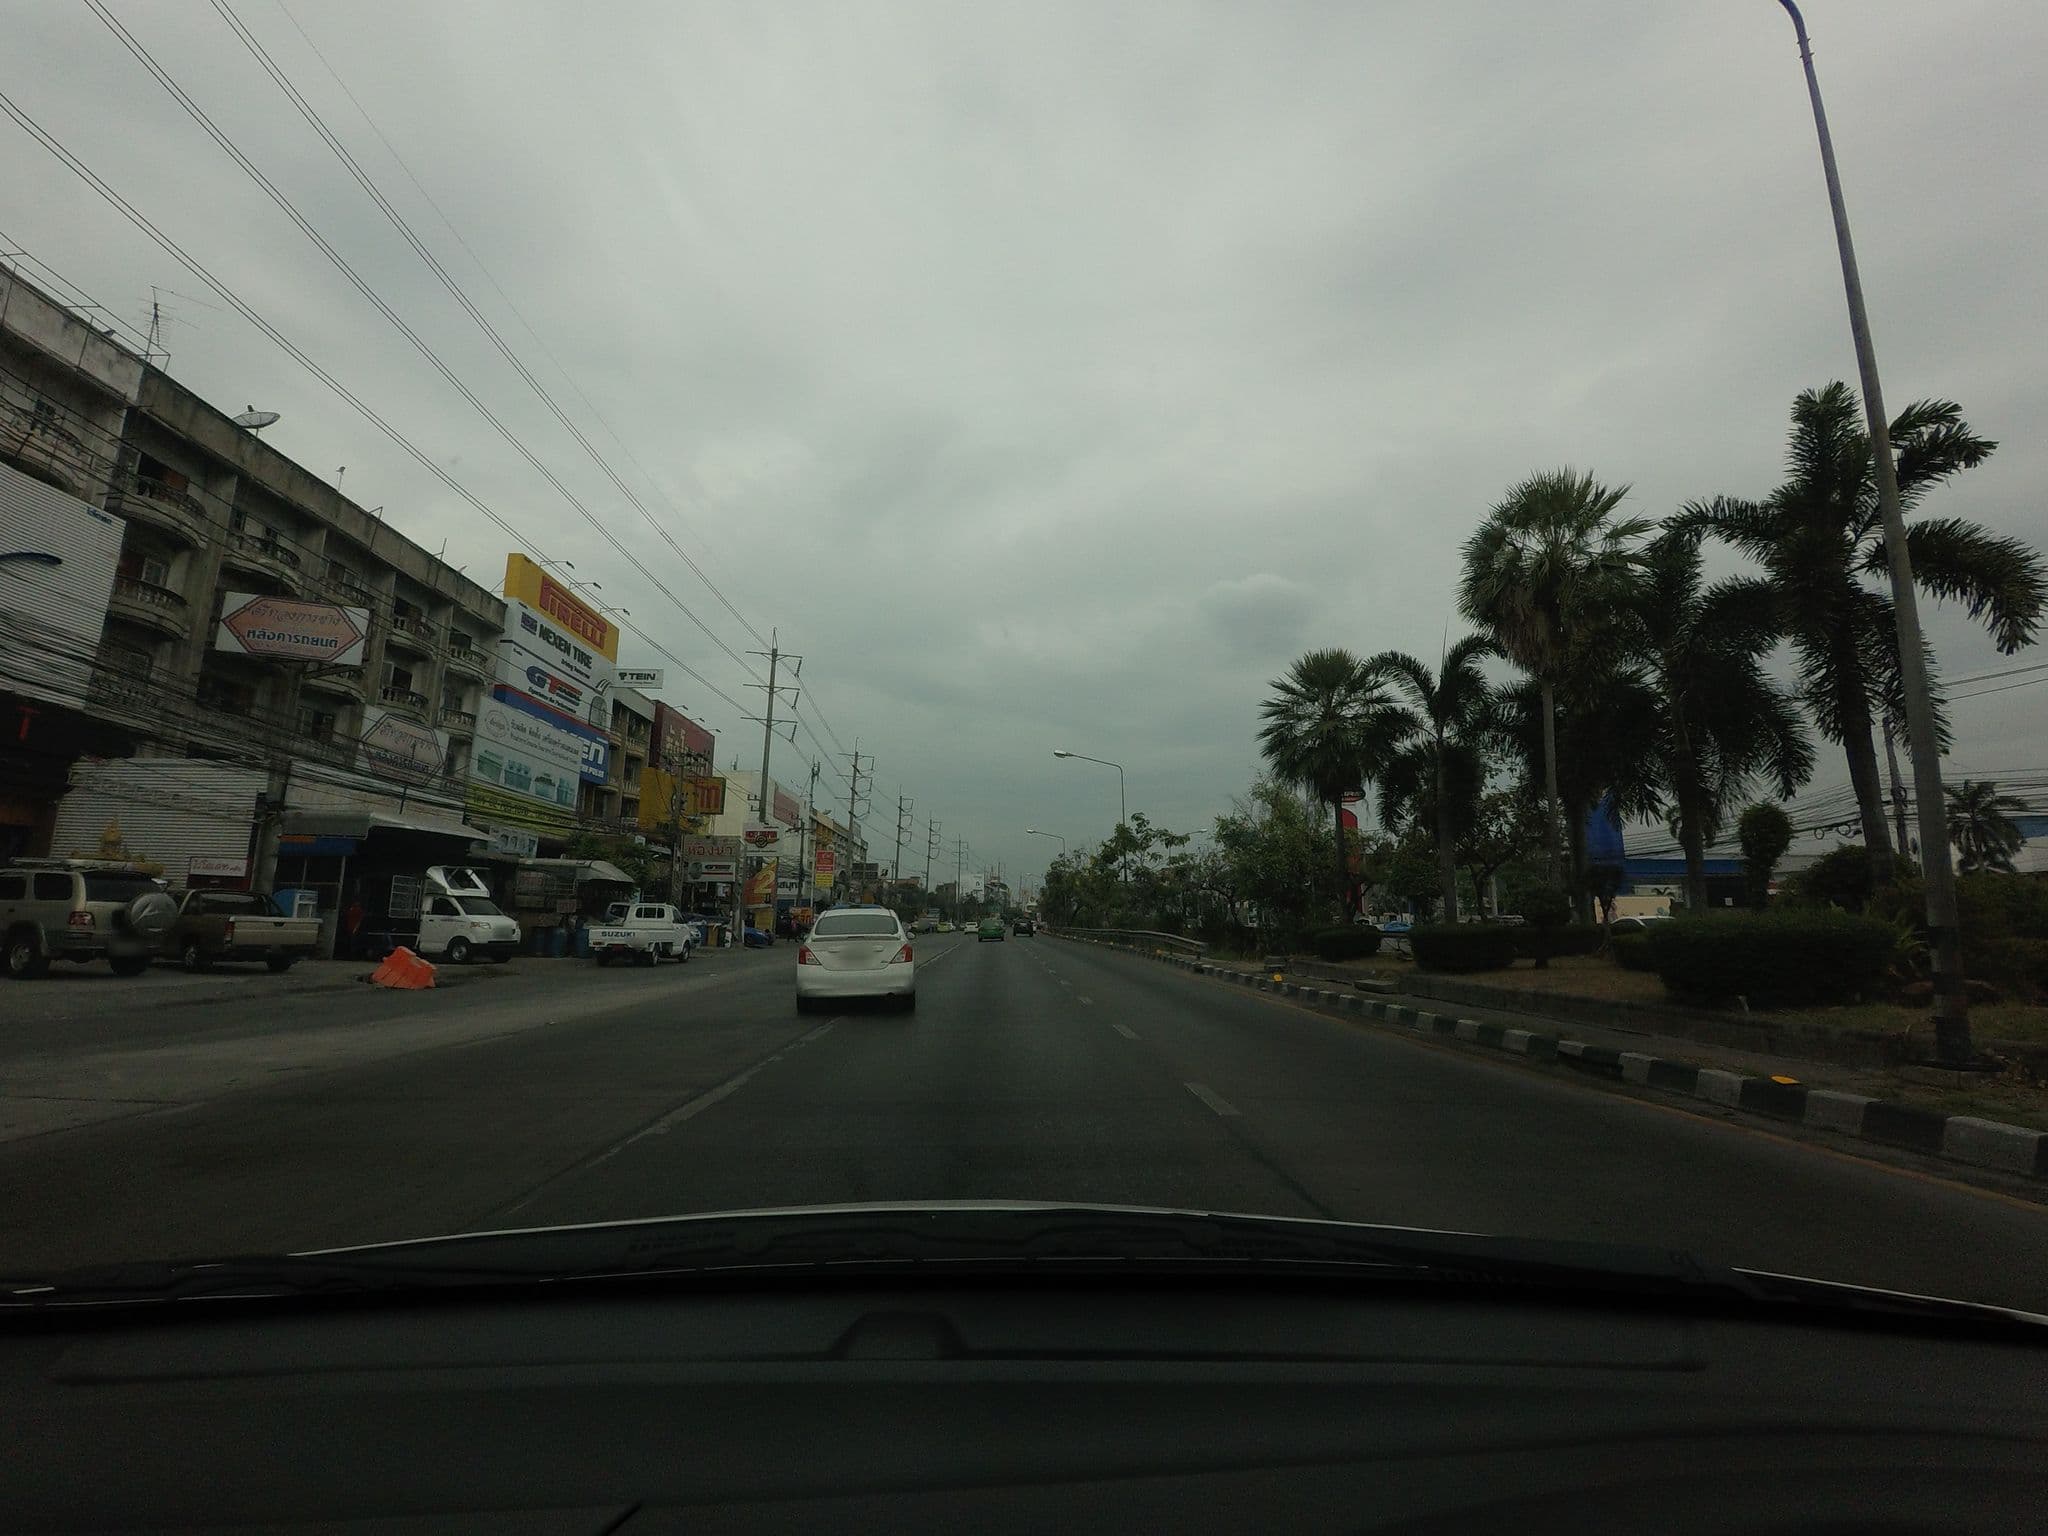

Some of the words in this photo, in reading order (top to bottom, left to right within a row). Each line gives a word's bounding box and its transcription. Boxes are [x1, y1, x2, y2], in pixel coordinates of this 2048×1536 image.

[539, 576, 607, 649] PIRELLI
[539, 624, 571, 657] NEXEN
[572, 646, 592, 670] TIRE
